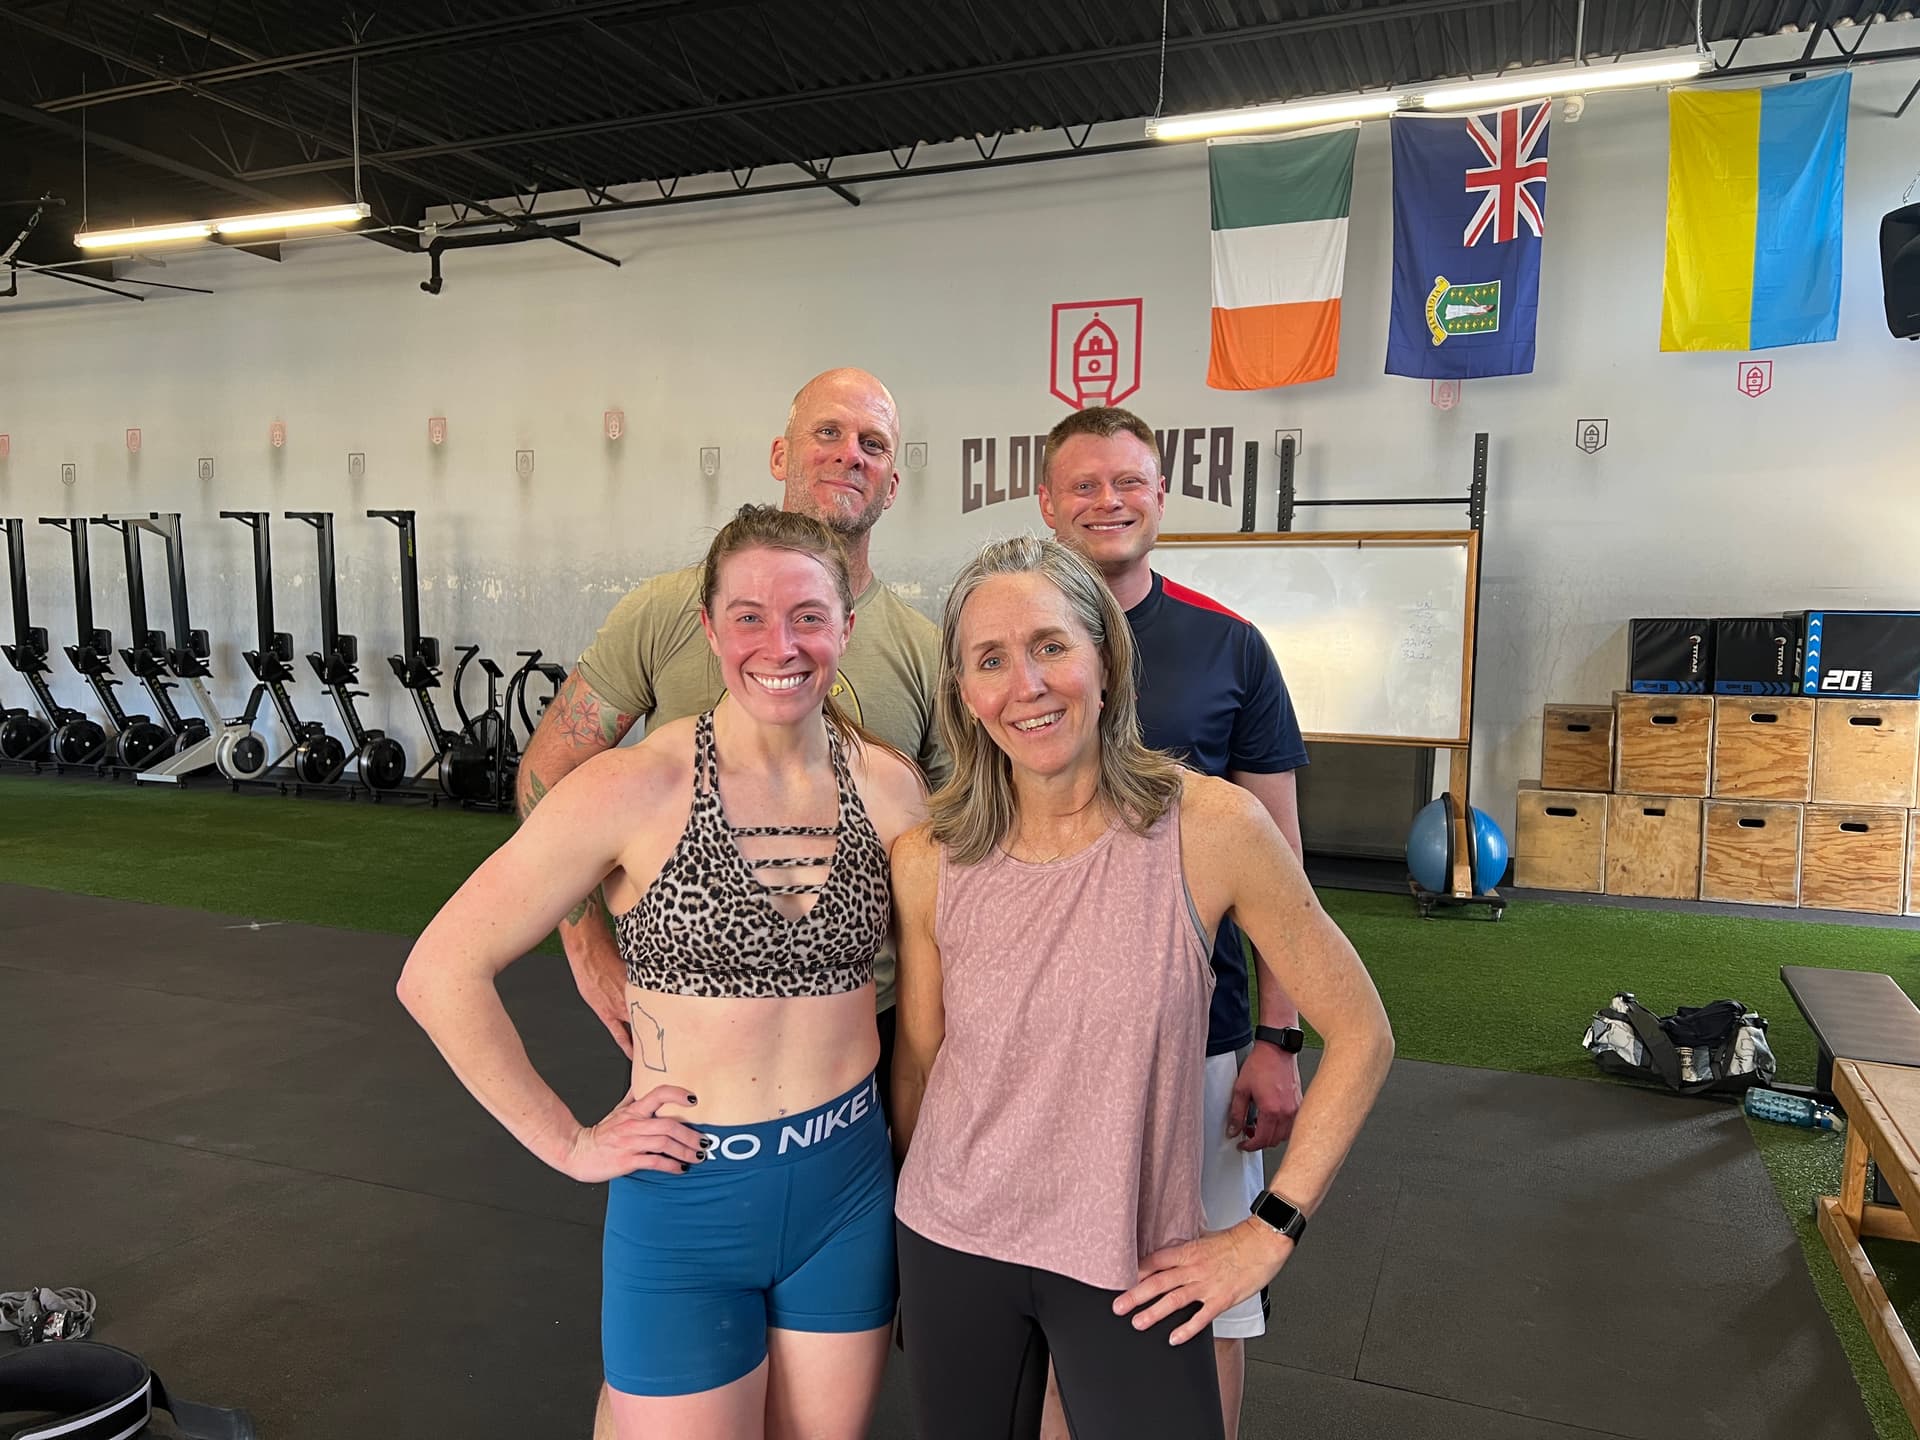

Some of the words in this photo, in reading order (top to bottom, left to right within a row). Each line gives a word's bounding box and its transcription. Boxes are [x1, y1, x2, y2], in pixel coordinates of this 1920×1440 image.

[1691, 644, 1699, 673] TITAN
[1821, 670, 1861, 690] 20
[1861, 670, 1873, 691] INCH
[704, 1133, 761, 1160] RO
[778, 1086, 870, 1154] NIKE
